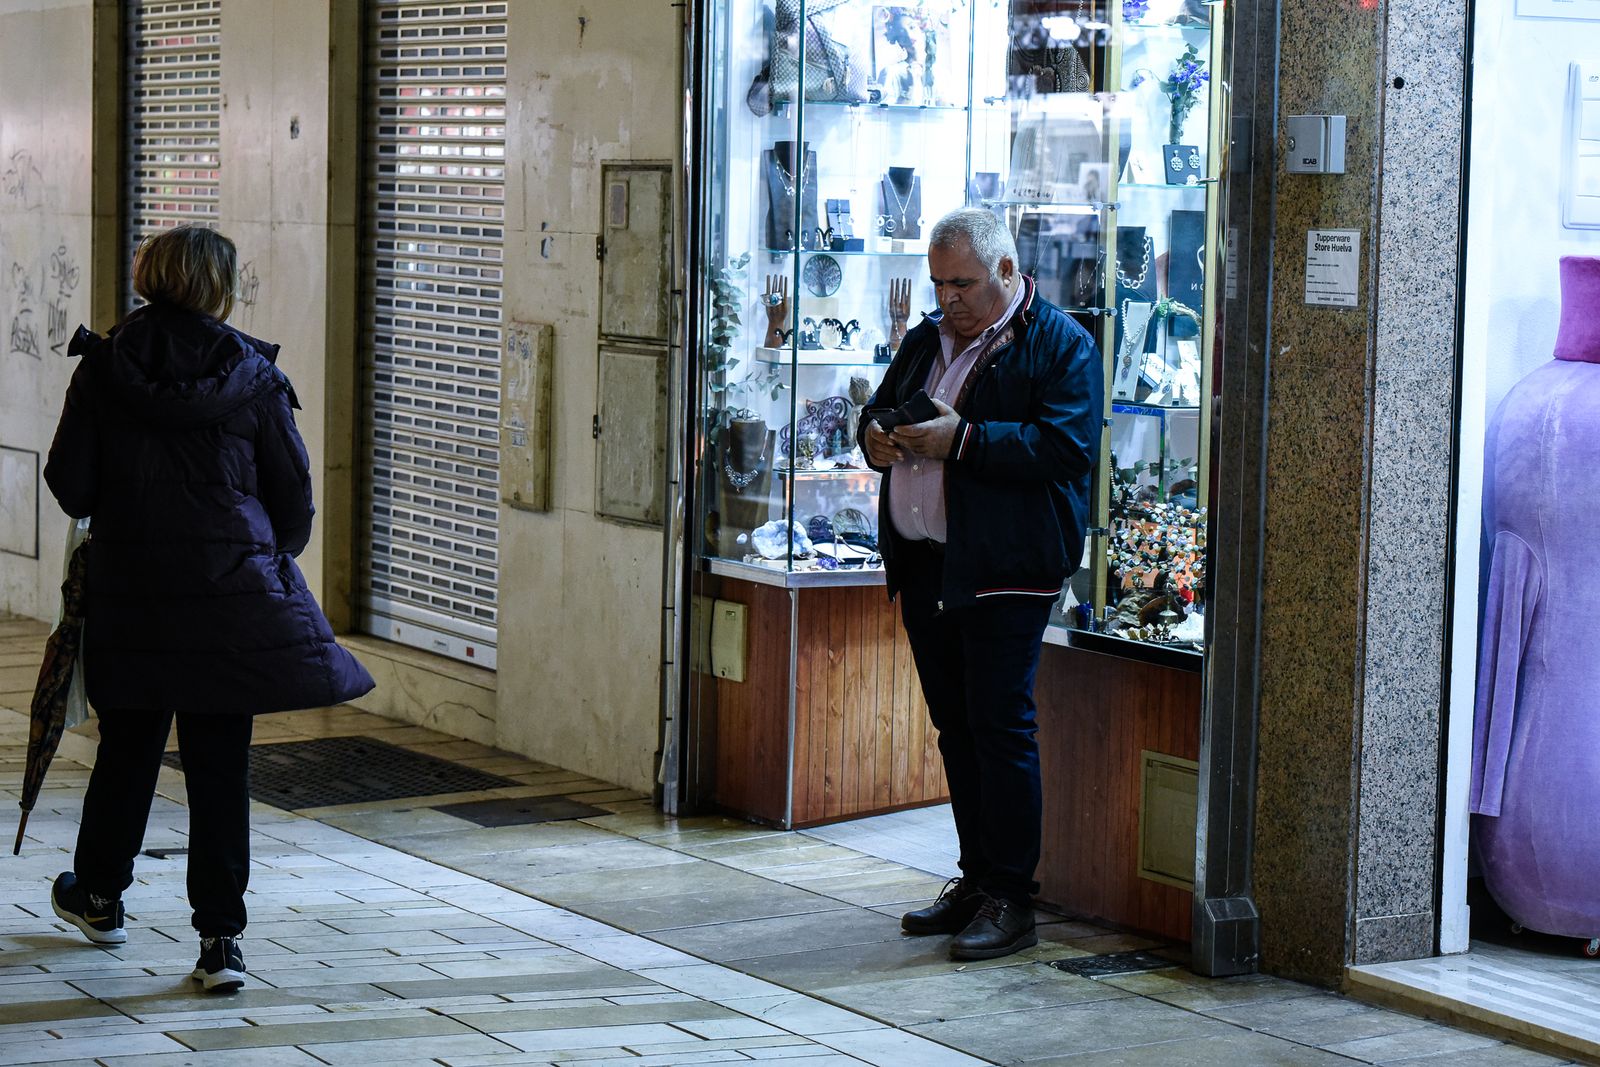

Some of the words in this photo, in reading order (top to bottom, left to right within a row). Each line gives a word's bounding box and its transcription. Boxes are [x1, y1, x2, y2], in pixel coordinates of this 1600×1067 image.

[1316, 233, 1351, 243] Tupperware
[1314, 242, 1331, 252] Store
[1331, 243, 1352, 254] Huelva
